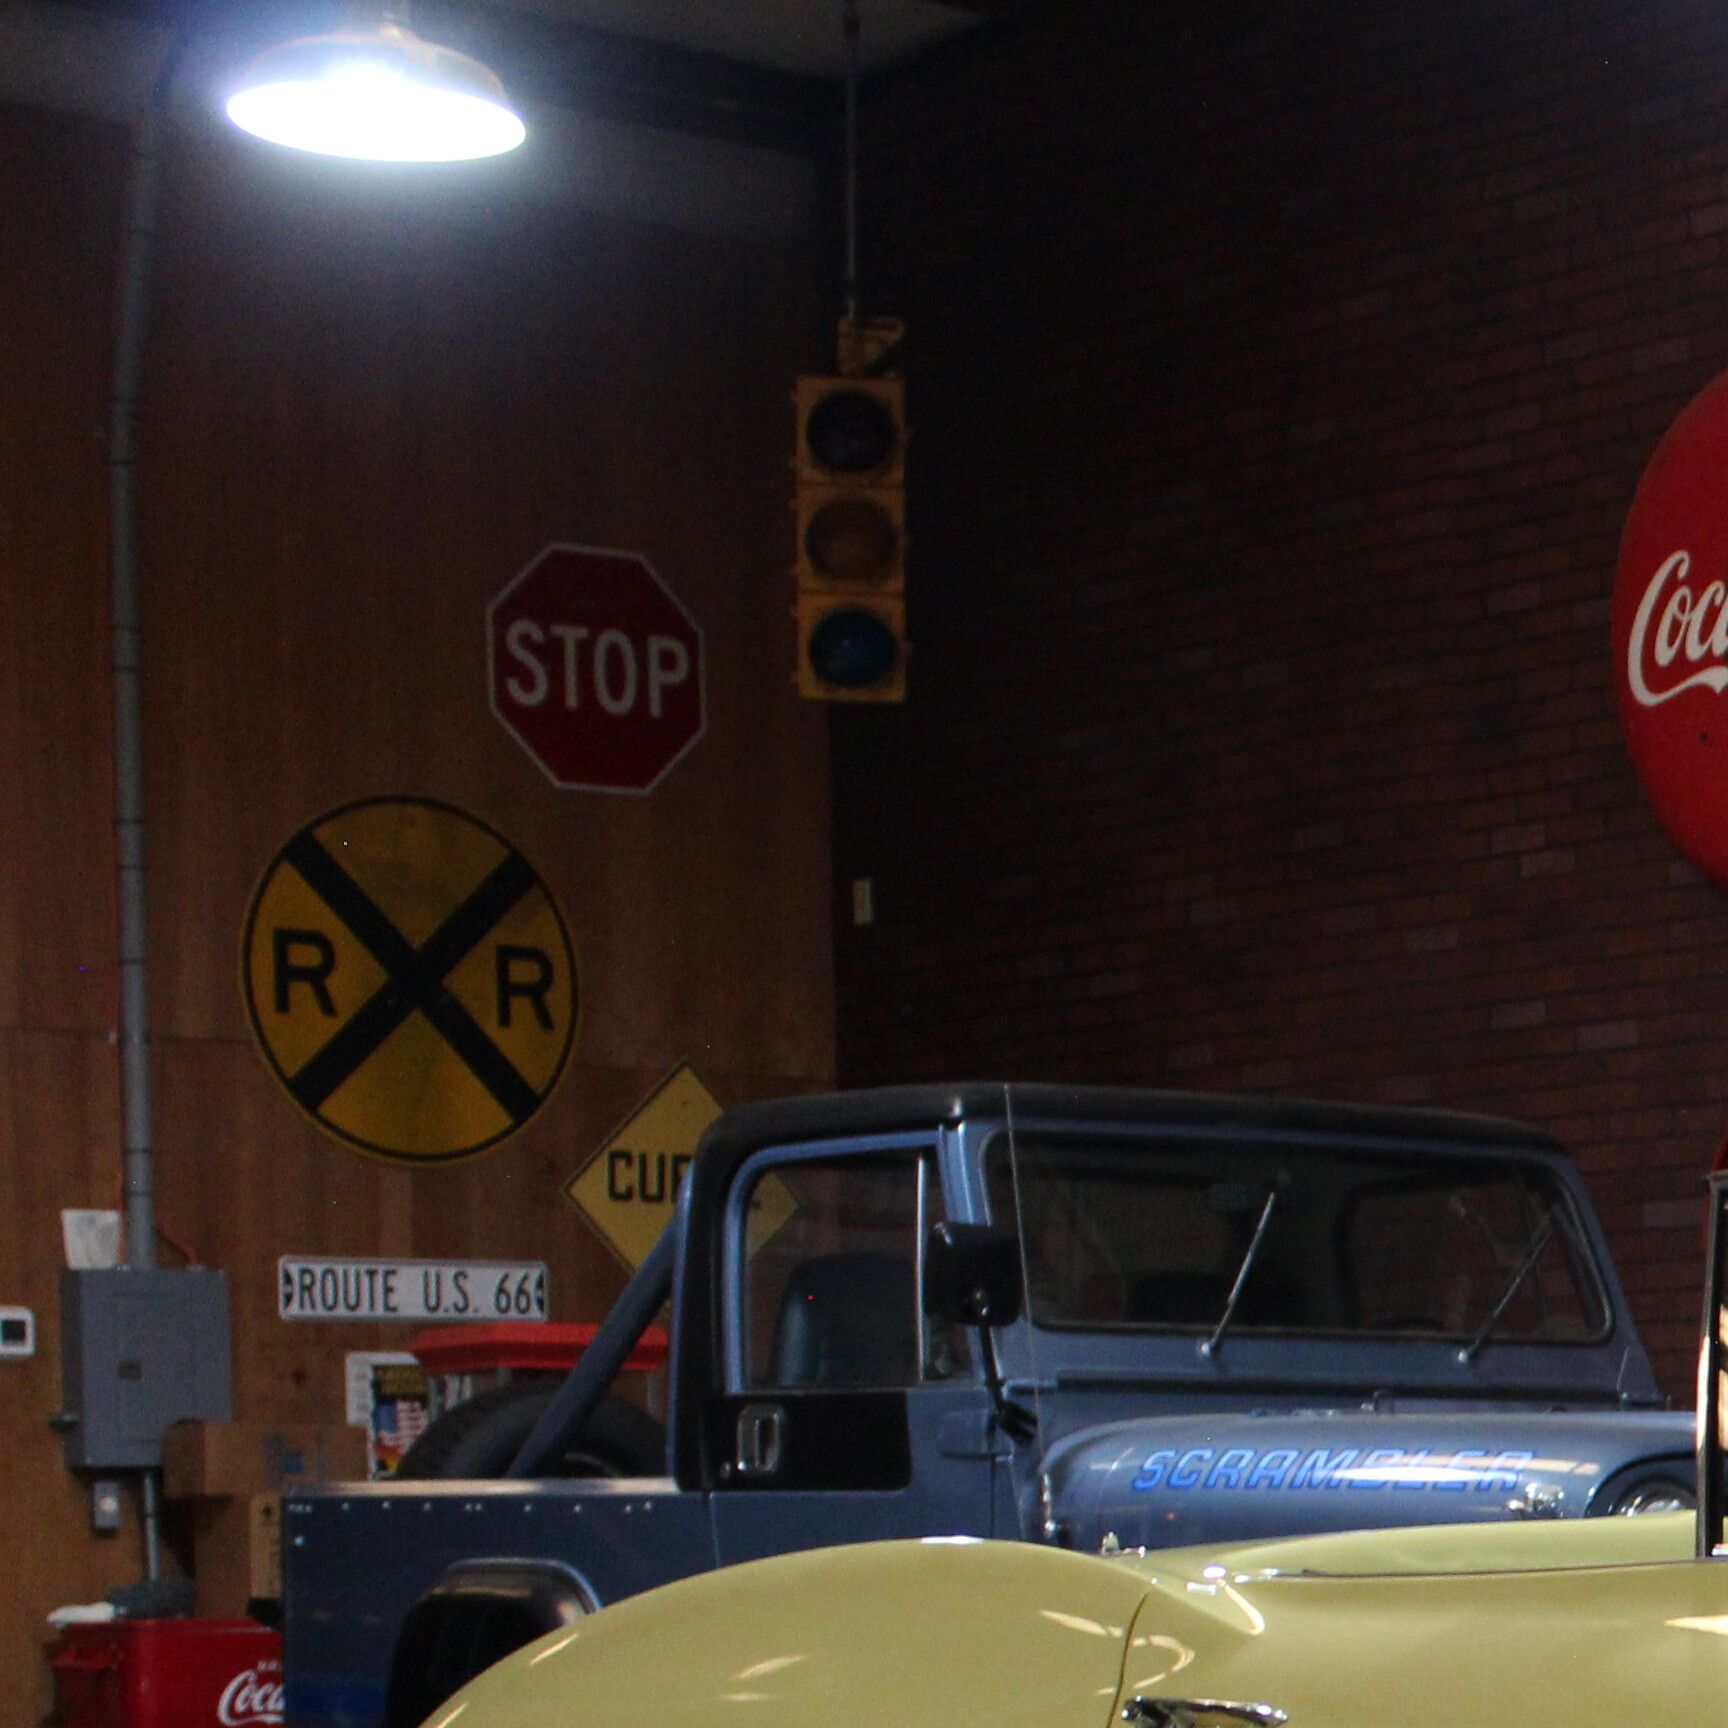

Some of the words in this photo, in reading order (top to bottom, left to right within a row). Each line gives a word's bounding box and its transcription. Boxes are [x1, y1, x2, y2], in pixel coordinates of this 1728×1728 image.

[506, 618, 690, 718] STOP
[273, 928, 336, 1016] R
[496, 943, 554, 1031] R
[299, 1267, 397, 1312] ROUTE
[422, 1270, 478, 1313] U.S.
[494, 1273, 530, 1314] 66
[1132, 1447, 1537, 1492] SCRAMBLER
